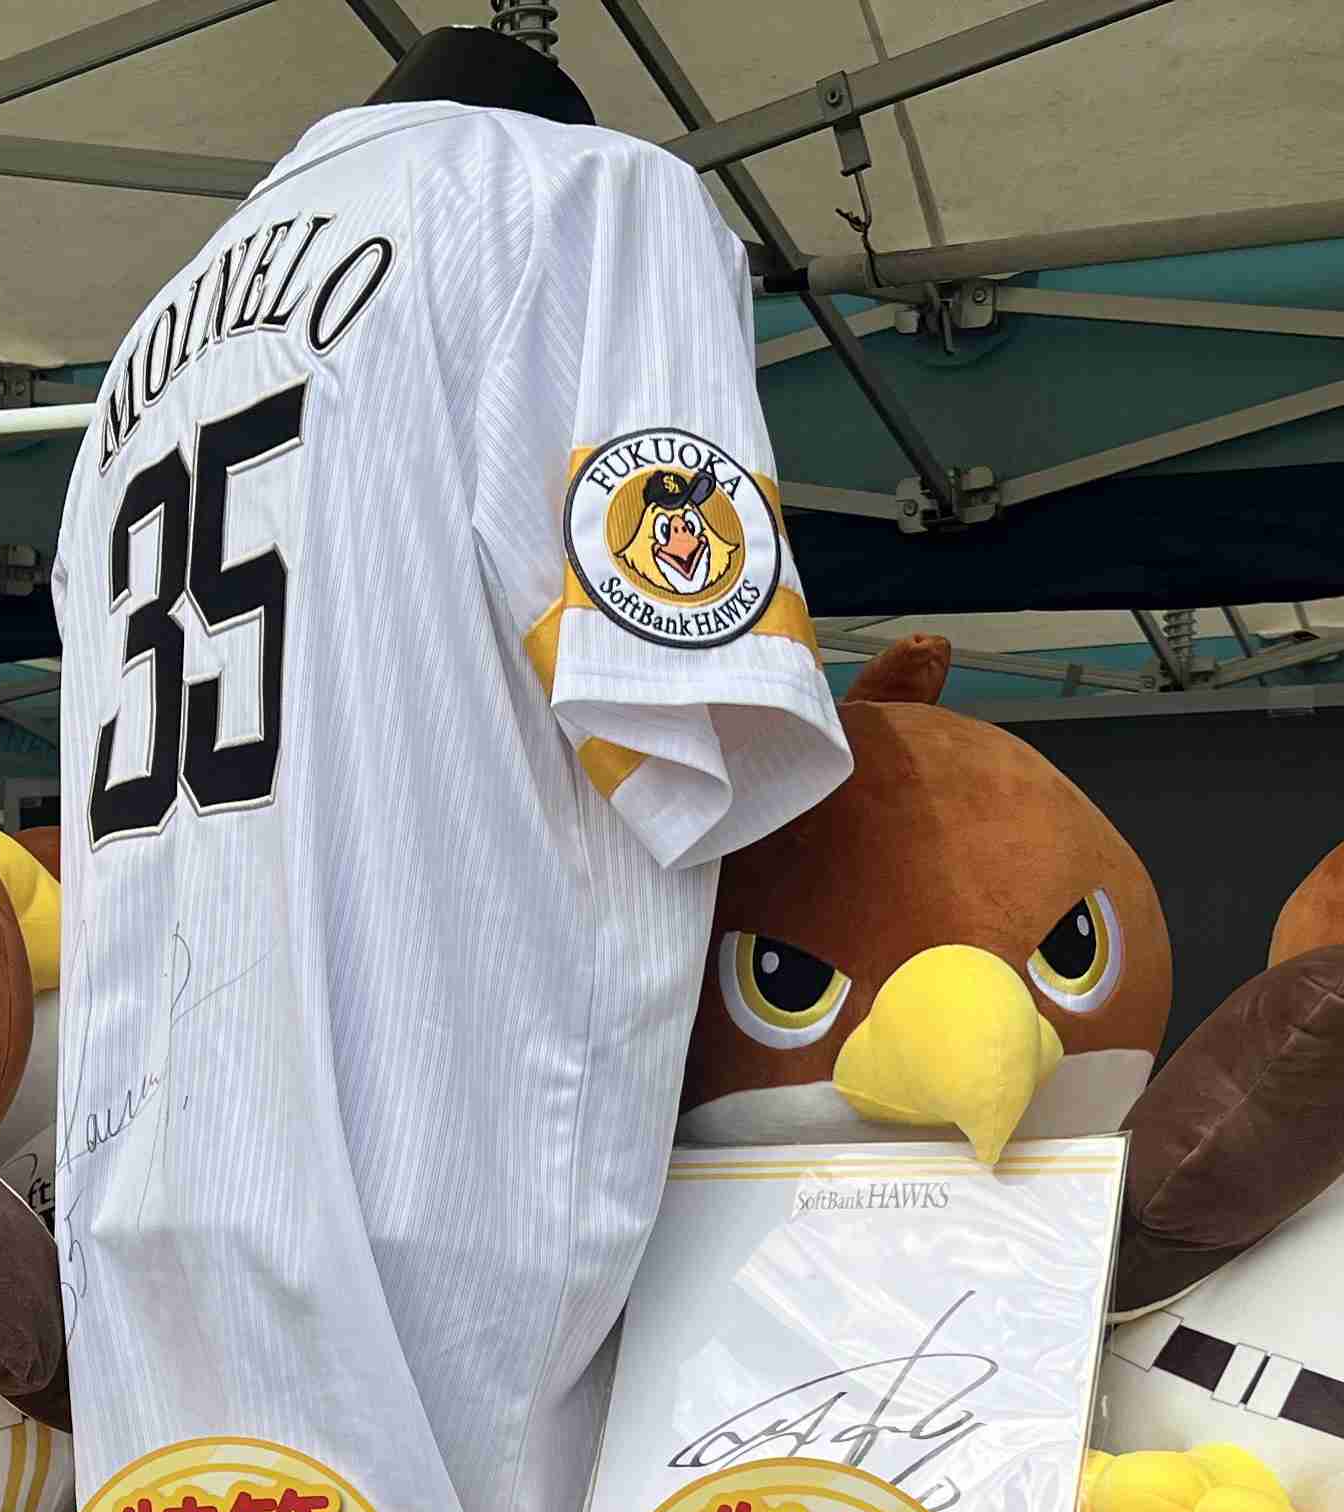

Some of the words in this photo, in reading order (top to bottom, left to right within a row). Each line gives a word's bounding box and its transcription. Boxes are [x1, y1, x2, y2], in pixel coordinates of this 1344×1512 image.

[98, 210, 398, 477] MOINELO
[586, 438, 743, 501] FUKUOKA
[87, 375, 311, 852] 35
[600, 576, 695, 638] SoftBank
[694, 579, 761, 637] HAWKS
[796, 1190, 865, 1210] SoftBank
[865, 1182, 951, 1209] HAWKS
